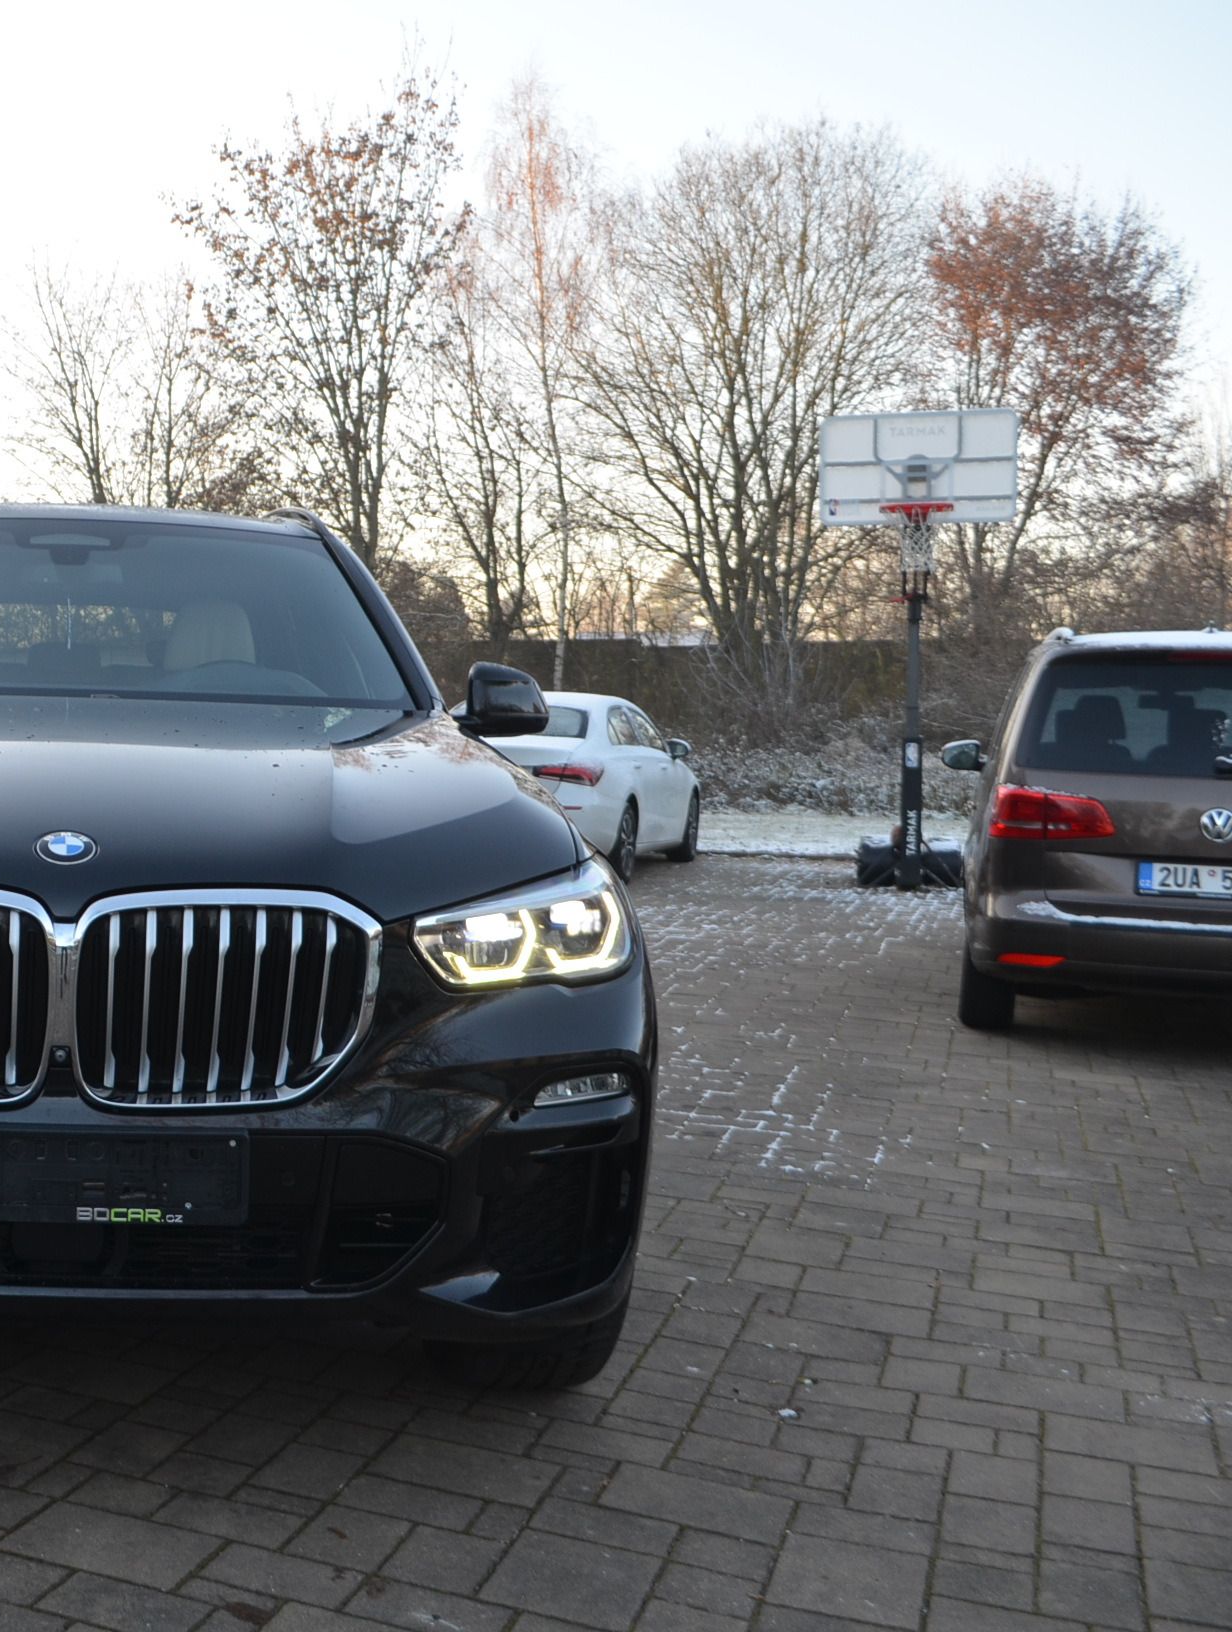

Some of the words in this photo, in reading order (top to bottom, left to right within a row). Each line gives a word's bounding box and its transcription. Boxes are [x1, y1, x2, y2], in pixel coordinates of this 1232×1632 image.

[888, 425, 946, 437] TARMAK
[905, 809, 918, 856] TARMAK
[1158, 866, 1201, 889] 2UA
